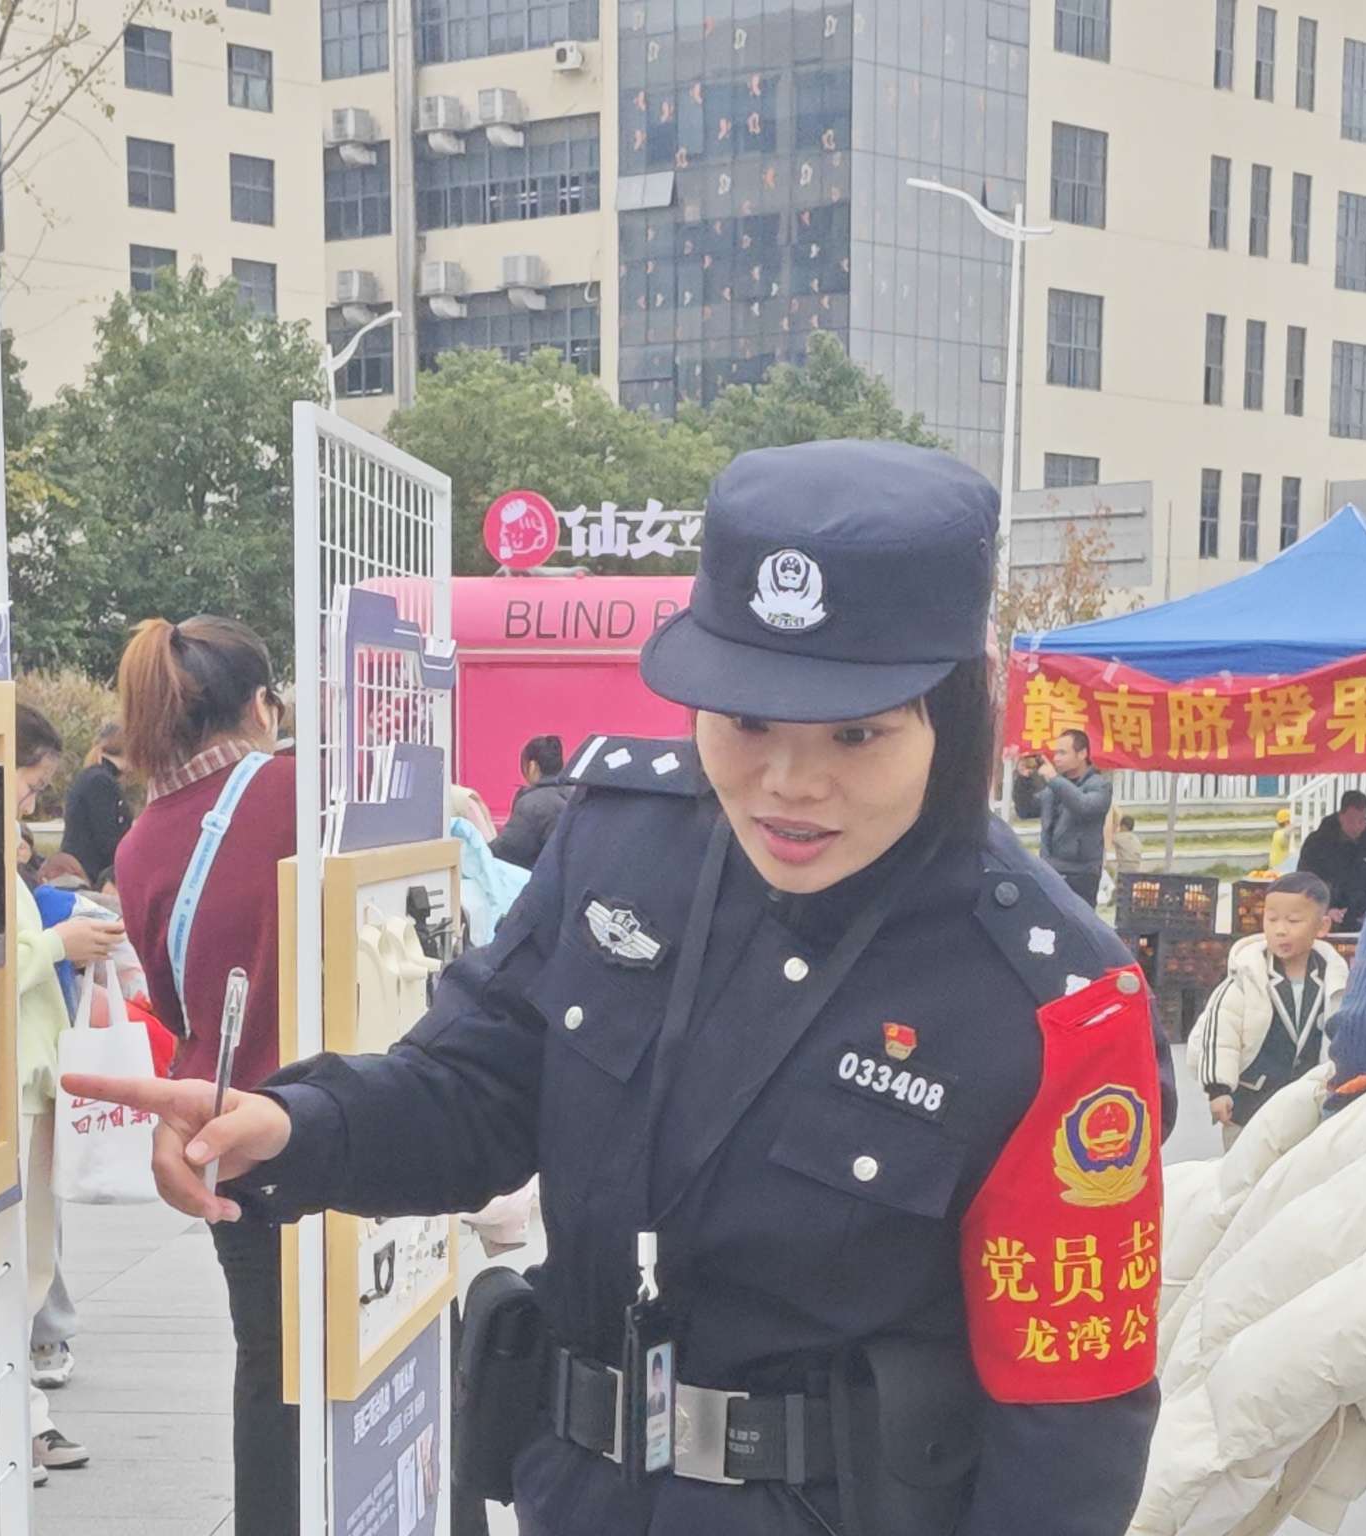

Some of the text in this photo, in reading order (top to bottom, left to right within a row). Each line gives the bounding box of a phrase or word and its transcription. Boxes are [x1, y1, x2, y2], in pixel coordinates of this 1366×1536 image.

[564, 498, 683, 559] 仙女
[504, 599, 636, 640] BLIND
[838, 1051, 945, 1112] 033408
[981, 1220, 1157, 1307] 党员志
[1015, 1304, 1149, 1362] 龙湾公
